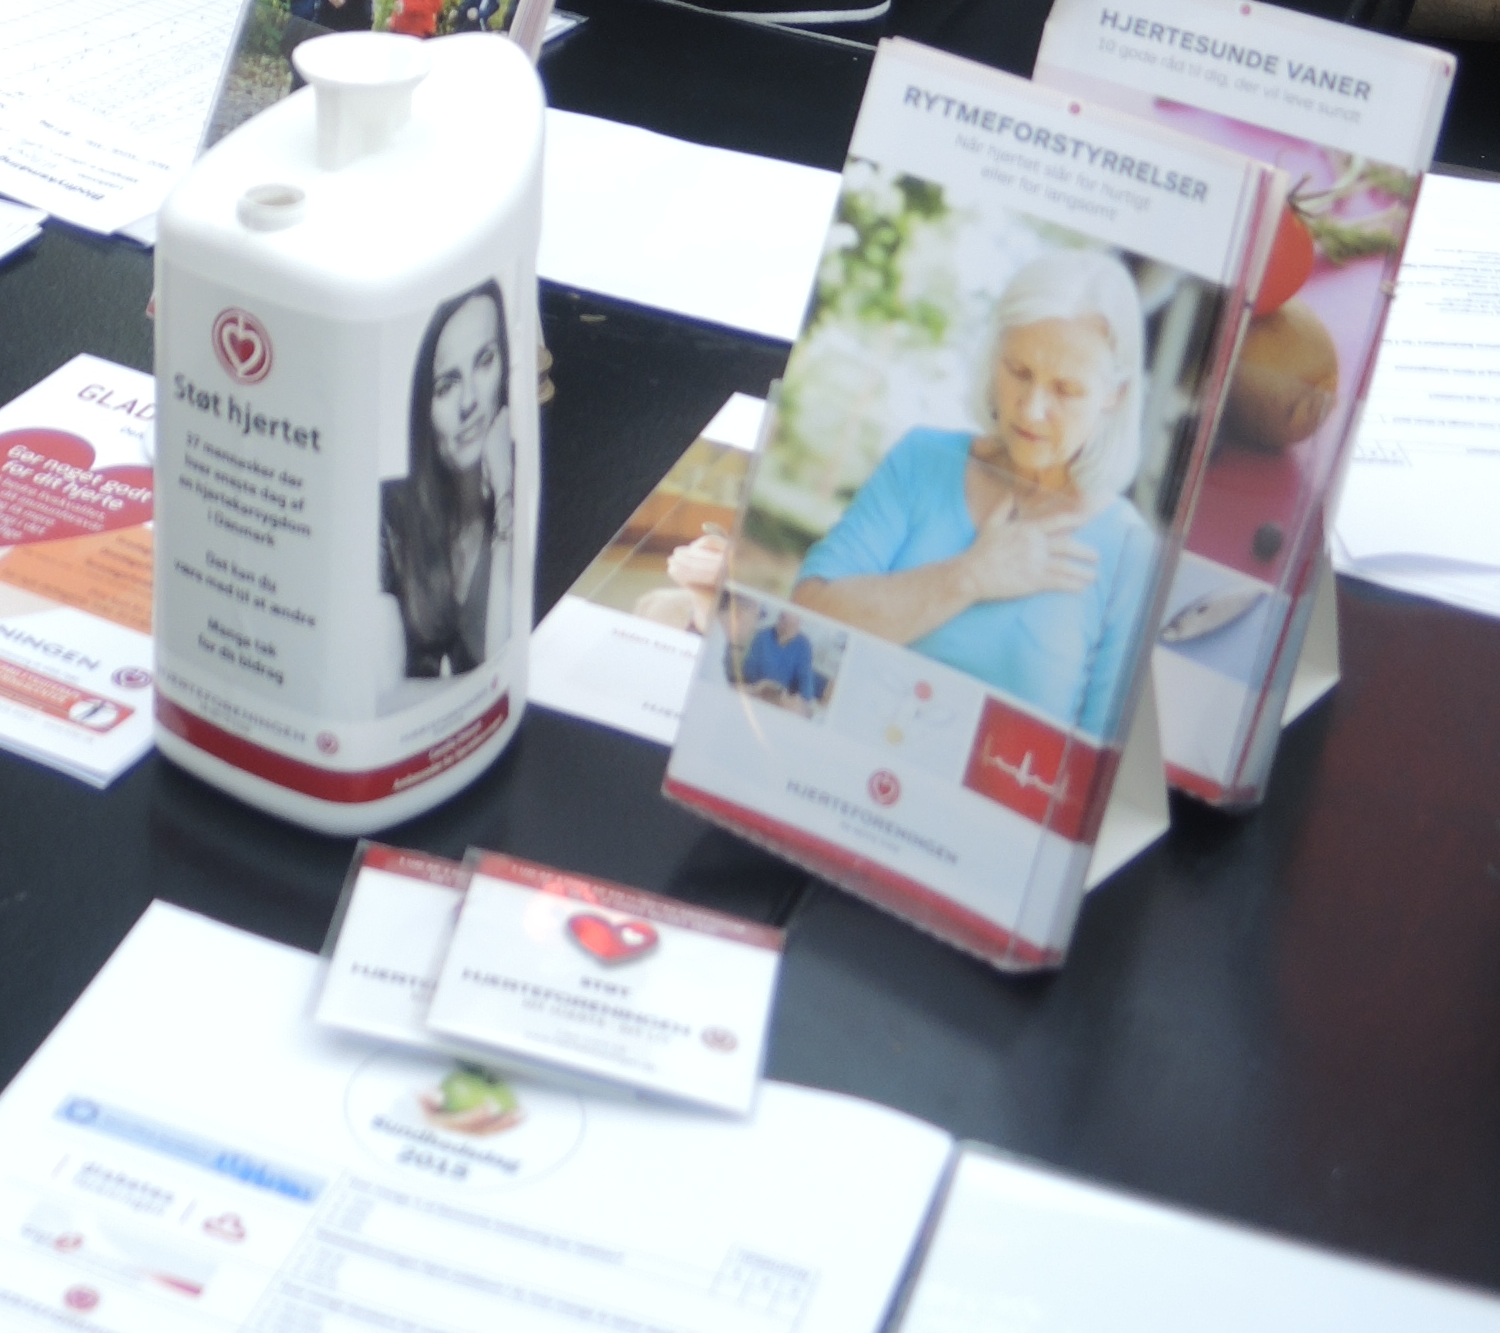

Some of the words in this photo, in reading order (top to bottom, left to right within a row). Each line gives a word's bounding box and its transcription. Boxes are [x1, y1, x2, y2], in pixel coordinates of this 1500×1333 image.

[1100, 9, 1280, 76] HJERTESUNDE
[1286, 60, 1372, 101] VANER
[1119, 44, 1156, 66] gode
[1161, 53, 1185, 73] råd
[1283, 87, 1315, 109] leve
[1317, 96, 1362, 124] sundt
[903, 84, 1209, 203] RYTMEFORSTYRRELSER
[955, 133, 984, 154] Når
[988, 141, 1041, 173] hjertet
[1044, 159, 1073, 182] slår
[1076, 169, 1099, 191] for
[1102, 178, 1151, 212] hurtigt
[980, 164, 1016, 187] eller
[1019, 174, 1042, 194] for
[1044, 184, 1118, 222] langsomt
[174, 372, 220, 417] Støt
[227, 393, 321, 454] hjertet
[2, 459, 34, 478] for
[33, 472, 63, 490] dit
[63, 480, 124, 511] hjerte
[8, 445, 45, 465] Gør
[43, 459, 104, 486] noget
[100, 480, 153, 503] godt
